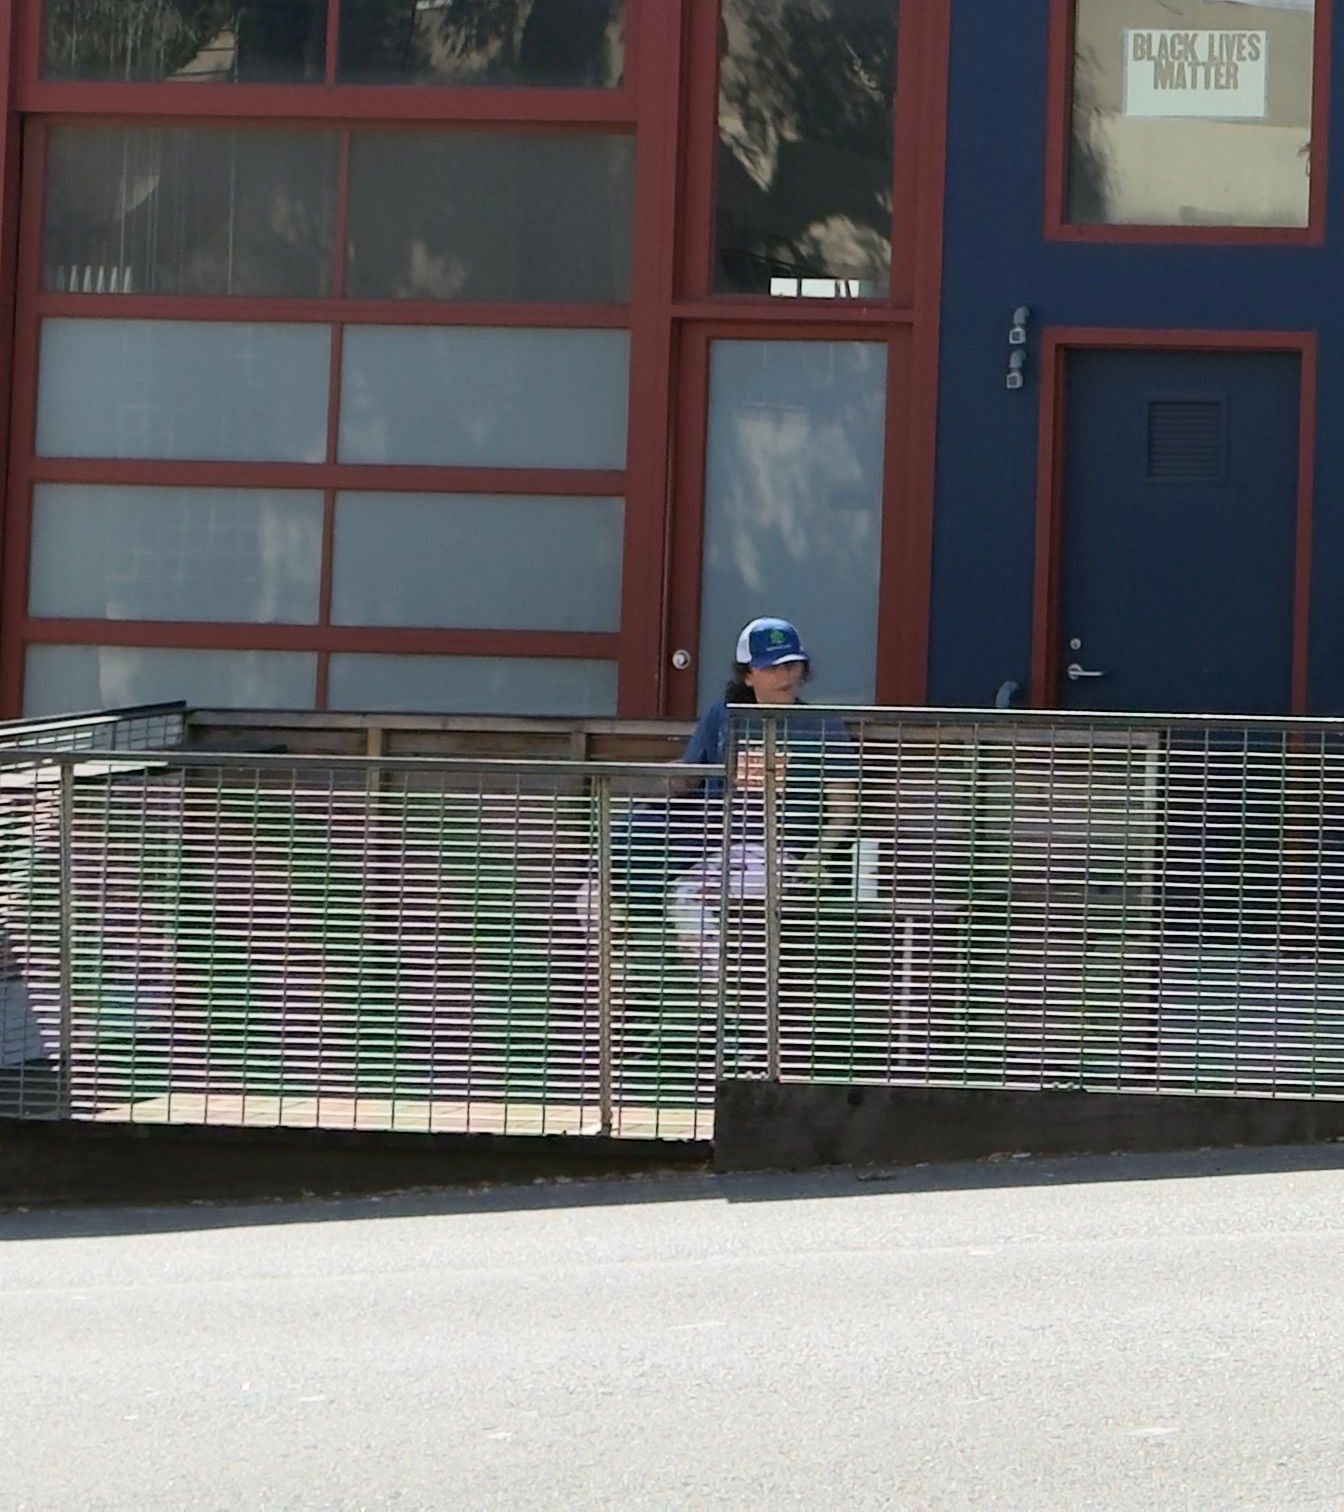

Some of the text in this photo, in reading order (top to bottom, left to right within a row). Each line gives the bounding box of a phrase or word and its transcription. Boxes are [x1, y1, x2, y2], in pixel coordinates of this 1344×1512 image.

[1133, 32, 1261, 62] BLACK LIVES
[1153, 61, 1239, 90] MATTER
